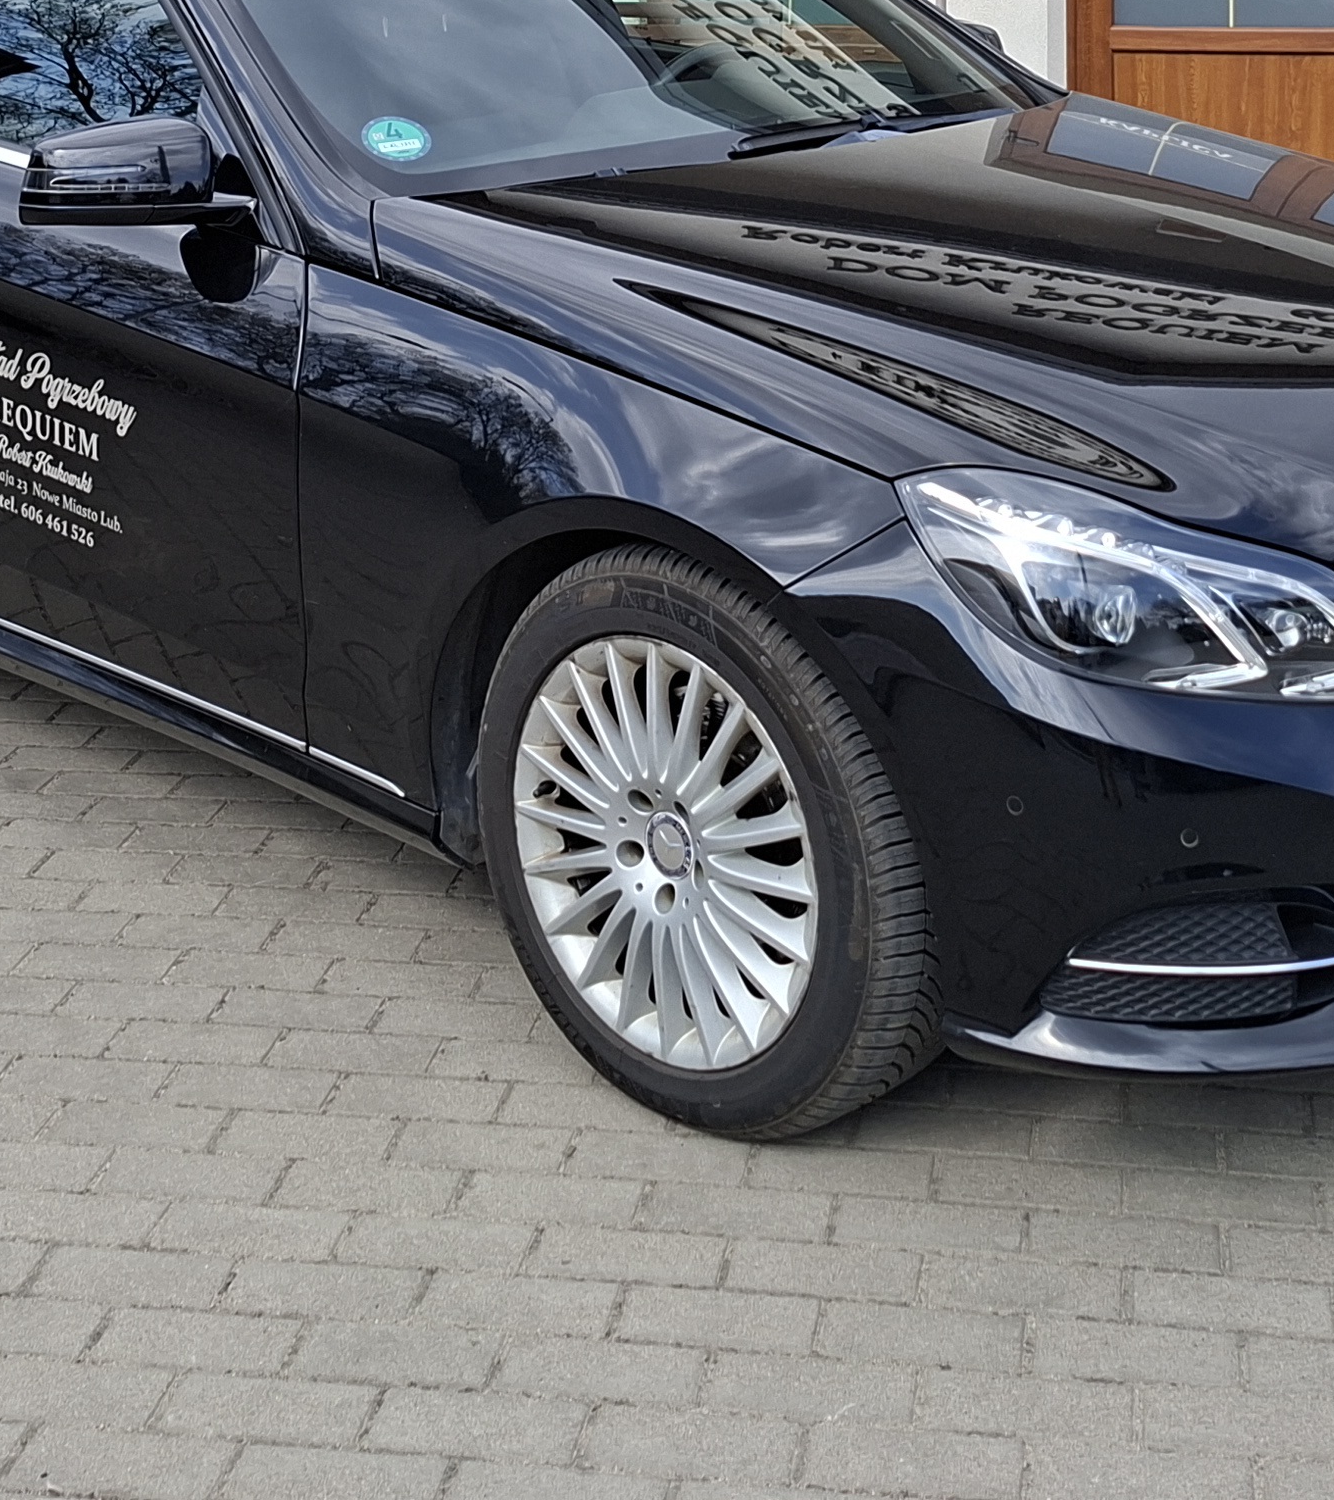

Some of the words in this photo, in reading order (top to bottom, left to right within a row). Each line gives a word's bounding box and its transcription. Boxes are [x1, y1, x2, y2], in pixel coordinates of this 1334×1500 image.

[386, 122, 403, 139] 4
[20, 352, 137, 437] Pogrzebowy
[32, 450, 93, 494] Krukowski
[16, 478, 28, 495] 23
[32, 480, 60, 506] Nowe
[62, 494, 98, 523] Miasto
[100, 510, 123, 534] Lub.
[20, 502, 43, 525] 606
[45, 513, 68, 537] 461
[70, 523, 95, 548] 526
